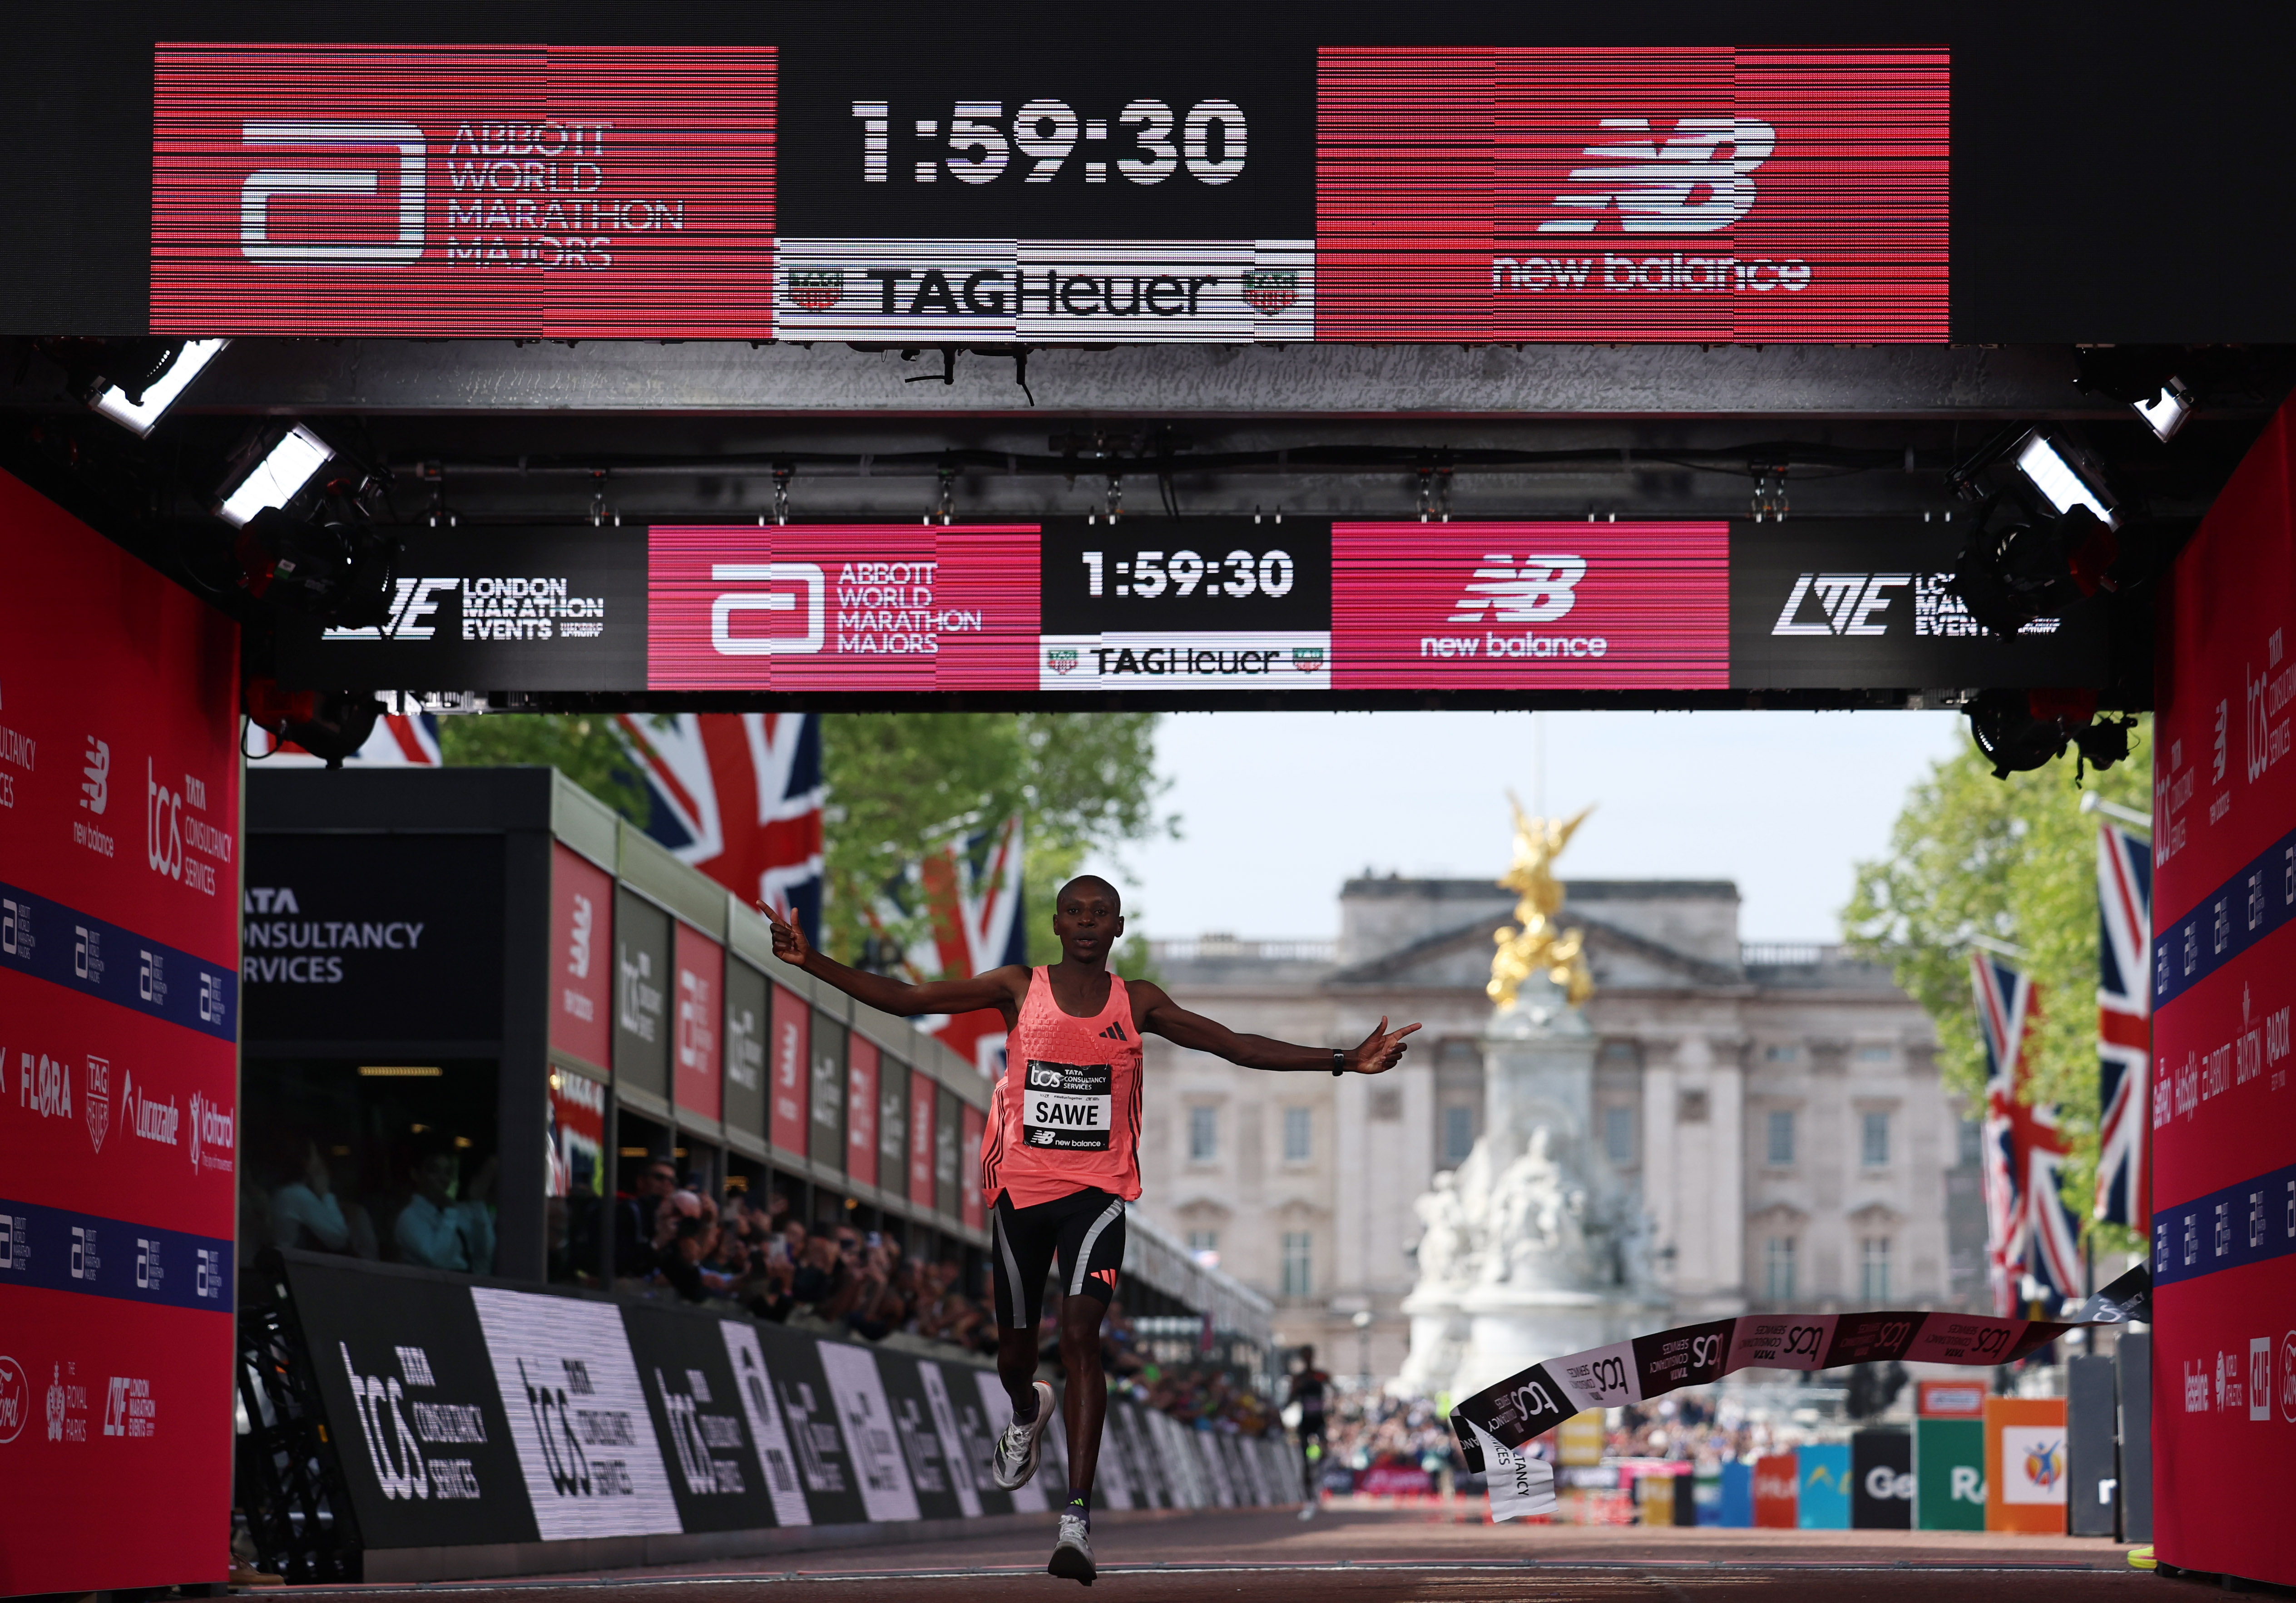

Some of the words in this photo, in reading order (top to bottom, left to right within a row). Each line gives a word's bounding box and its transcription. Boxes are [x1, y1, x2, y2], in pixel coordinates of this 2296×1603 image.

[449, 121, 614, 155] ABBOTT
[852, 99, 1247, 184] 1:59:30
[447, 162, 602, 192] WORLD
[447, 200, 683, 230] MARATHON
[448, 237, 612, 269] MAJORS
[1494, 257, 1592, 291] new
[1604, 253, 1811, 291] balance
[463, 578, 567, 598] LONDON
[838, 563, 938, 584] ABBOTT
[1082, 550, 1293, 597] 1:59:30
[462, 598, 603, 617] MARATHON
[837, 587, 931, 608] WORLD
[462, 619, 552, 640] EVENTS
[837, 609, 981, 631] MARATHON
[1915, 616, 1989, 636] EVEN
[838, 634, 938, 653] MAJORS
[1421, 638, 1480, 656] new
[1487, 632, 1607, 657] balance
[2247, 662, 2267, 784] tcs
[185, 774, 206, 811] TATA
[148, 755, 182, 881] tcs
[74, 822, 87, 846] new
[88, 822, 114, 858] balance
[185, 816, 232, 863] CONSULTANCY
[185, 857, 215, 897] SERVICES
[244, 922, 424, 949] NSULTANCY
[244, 957, 343, 983] RVICES
[2267, 1006, 2289, 1067] RADOX
[2237, 1027, 2261, 1085] BUXTON
[21, 1053, 72, 1119] FLORA
[89, 1062, 108, 1094] TAG
[1031, 1065, 1061, 1088] tcs
[136, 1085, 178, 1145] Lucozade
[1036, 1102, 1099, 1125] SAWE
[1692, 1333, 1723, 1370] tcs
[1754, 1350, 1775, 1360] TATA
[1783, 1326, 1823, 1362] tcs
[1945, 1349, 1965, 1357] TATA
[1972, 1327, 2011, 1359] tcs
[129, 1379, 149, 1398] LONDON
[1592, 1356, 1628, 1395] tcs
[1671, 1367, 1688, 1381] TATA
[67, 1385, 88, 1409] ROYAL
[129, 1398, 155, 1418] MARATHON
[1510, 1381, 1559, 1421] tcs
[66, 1419, 86, 1442] PARKS
[129, 1418, 146, 1437] EVENTS
[339, 1341, 429, 1500] tcs
